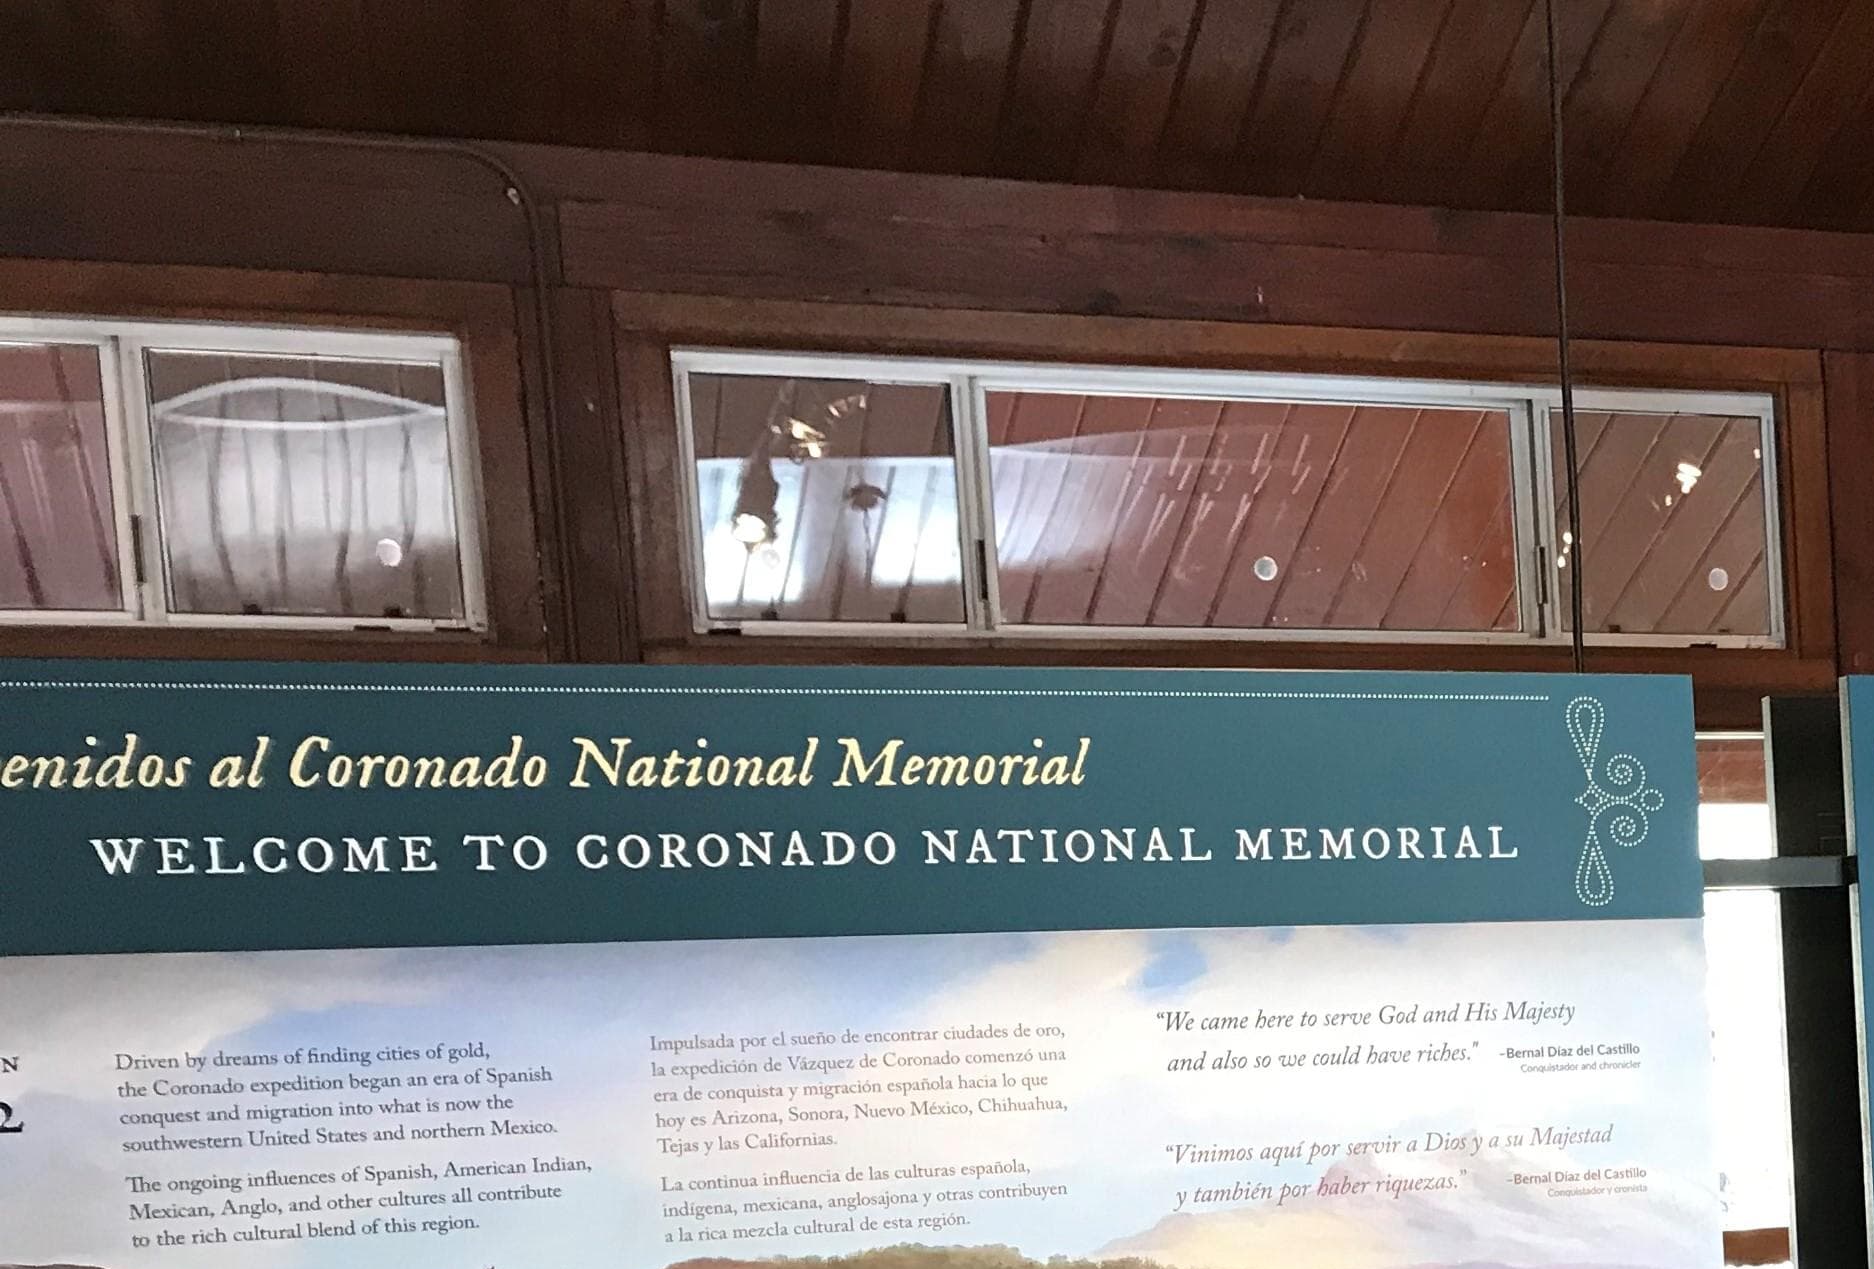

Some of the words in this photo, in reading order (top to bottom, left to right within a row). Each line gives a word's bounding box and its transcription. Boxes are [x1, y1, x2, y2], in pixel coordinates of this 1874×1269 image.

[0, 733, 192, 789] enidos
[209, 735, 270, 788] al
[289, 735, 547, 789] Coronado
[569, 736, 819, 788] National
[832, 737, 1091, 787] Memorial
[89, 836, 438, 875] WELCOME
[462, 834, 548, 871] TO
[576, 830, 896, 869] CORONADO
[921, 827, 1212, 864] NATIONAL
[1234, 825, 1518, 861] MEMORIAL
[1200, 1015, 1249, 1031] came
[1254, 1008, 1294, 1029] here
[1299, 1011, 1318, 1028] to
[1323, 1012, 1372, 1027] serve
[1378, 1003, 1419, 1025] God
[1422, 1002, 1461, 1024] and
[1464, 1001, 1498, 1022] His
[1502, 1000, 1576, 1026] Majesty
[114, 1053, 180, 1071] Driven
[184, 1051, 207, 1073] by
[212, 1050, 279, 1067] dreams
[283, 1047, 305, 1065] of
[307, 1046, 372, 1067] finding
[375, 1045, 421, 1062] cities
[425, 1042, 445, 1060] of
[447, 1041, 491, 1064] gold,
[1547, 1045, 1574, 1058] Díaz
[1576, 1044, 1594, 1057] del
[1596, 1042, 1641, 1056] Castillo
[117, 1081, 148, 1098] the
[152, 1077, 245, 1097] Coronado
[249, 1074, 344, 1097] expedition
[348, 1072, 402, 1094] began
[406, 1075, 429, 1087] an
[432, 1074, 460, 1086] era
[463, 1067, 483, 1085] of
[485, 1065, 553, 1089] Spanish
[1519, 1062, 1579, 1074] Conquistador
[1580, 1060, 1597, 1071] and
[1598, 1059, 1641, 1071] chronicler
